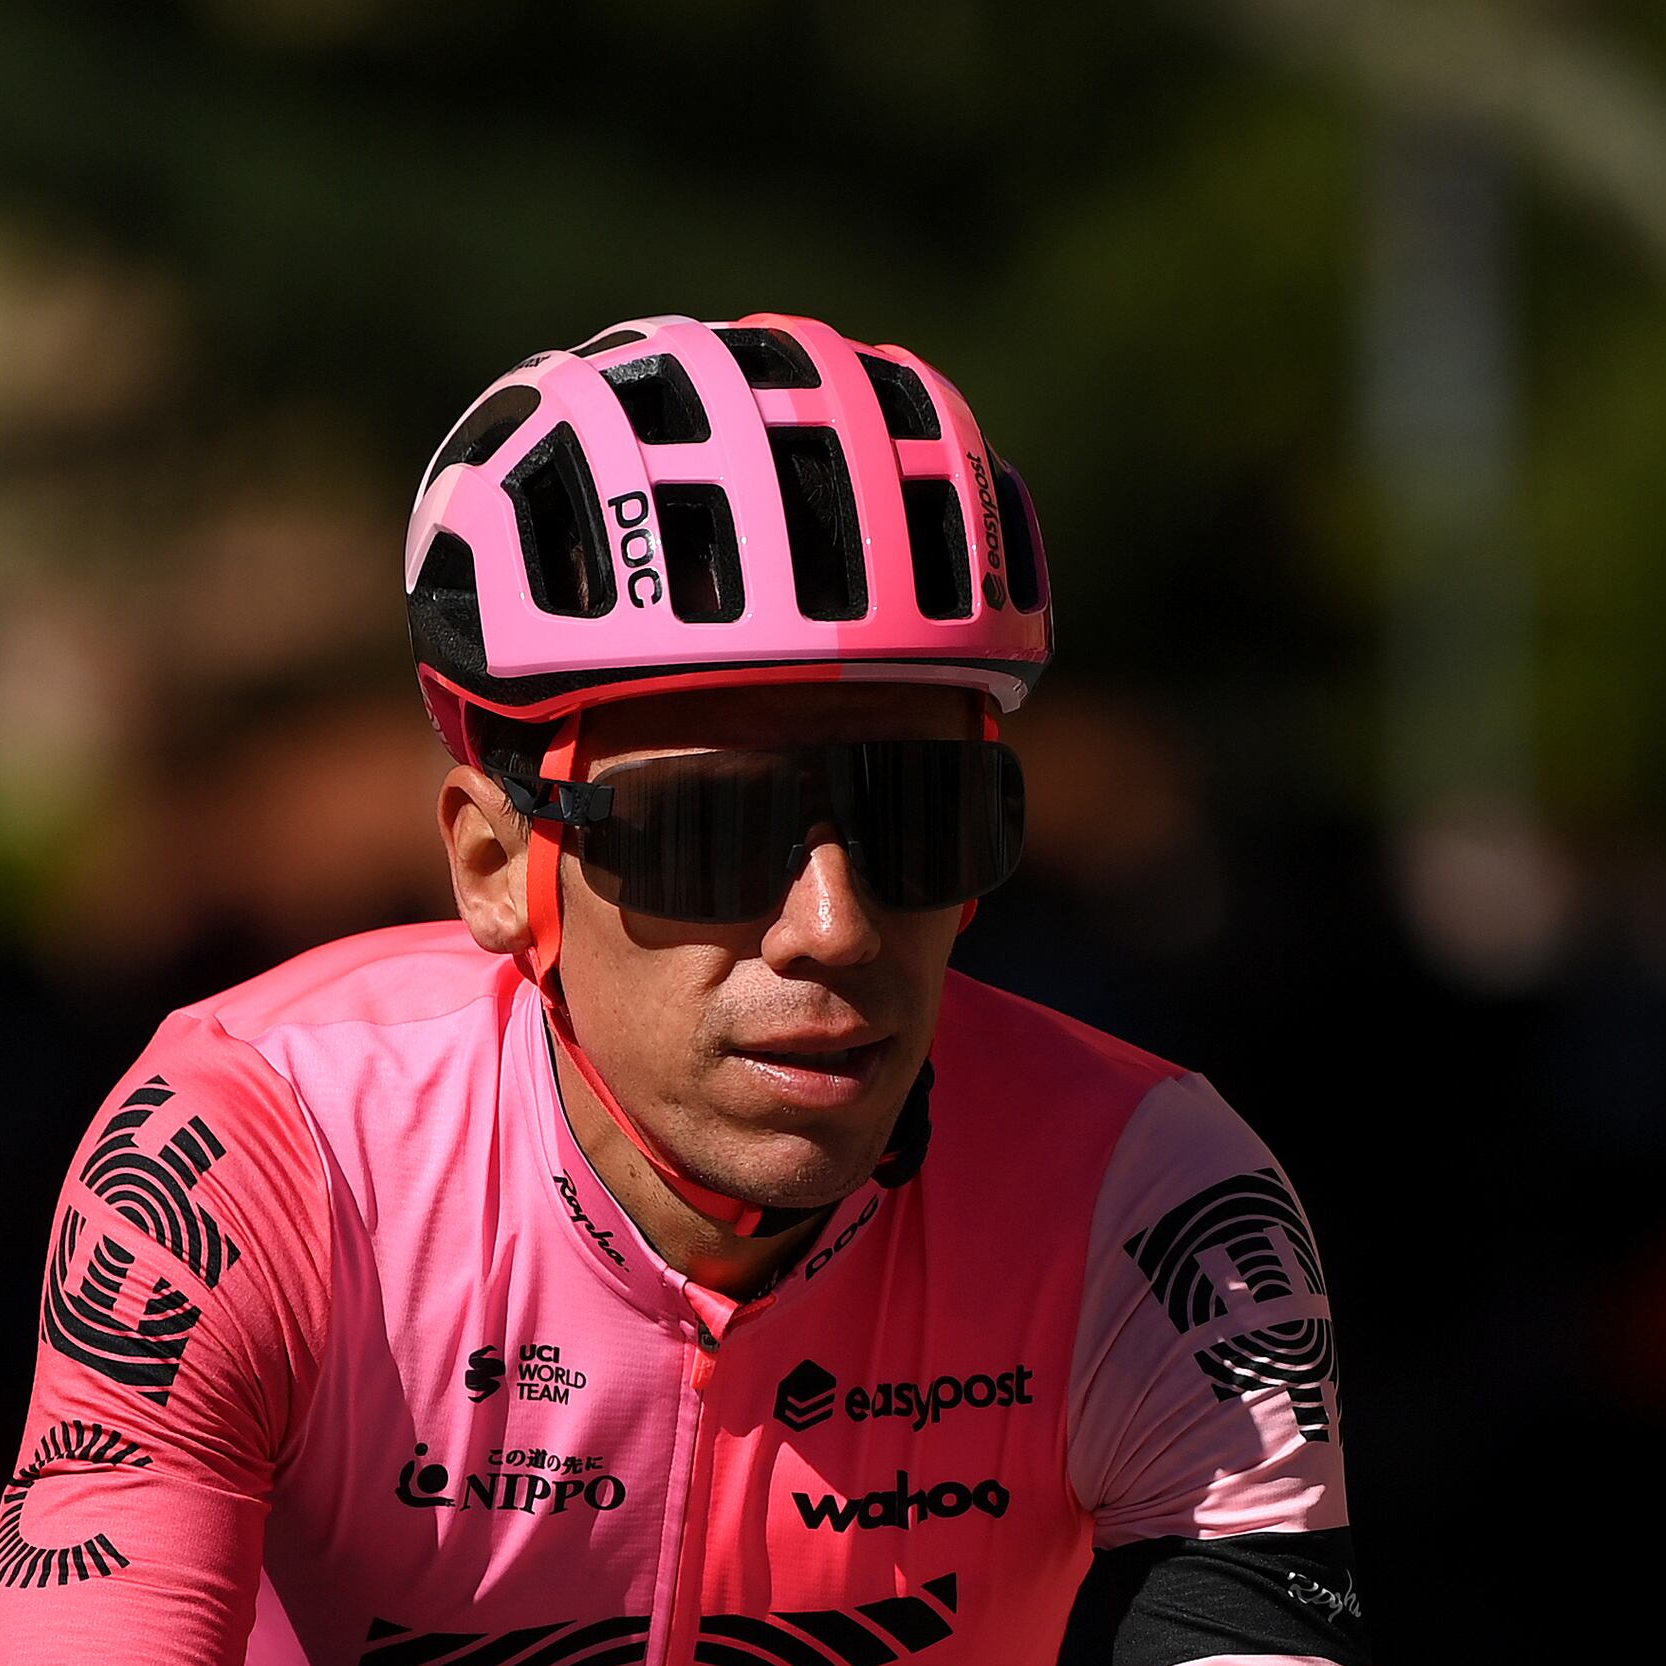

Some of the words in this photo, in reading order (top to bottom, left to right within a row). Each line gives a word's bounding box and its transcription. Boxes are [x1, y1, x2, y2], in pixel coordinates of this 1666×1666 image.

[519, 1343, 561, 1364] UCI
[518, 1364, 587, 1390] WORLD
[516, 1382, 571, 1406] TEAM
[844, 1363, 1034, 1433] easypost
[487, 1448, 605, 1476] この道の先に
[459, 1471, 627, 1516] NIPPO
[791, 1469, 1011, 1533] wahoo
